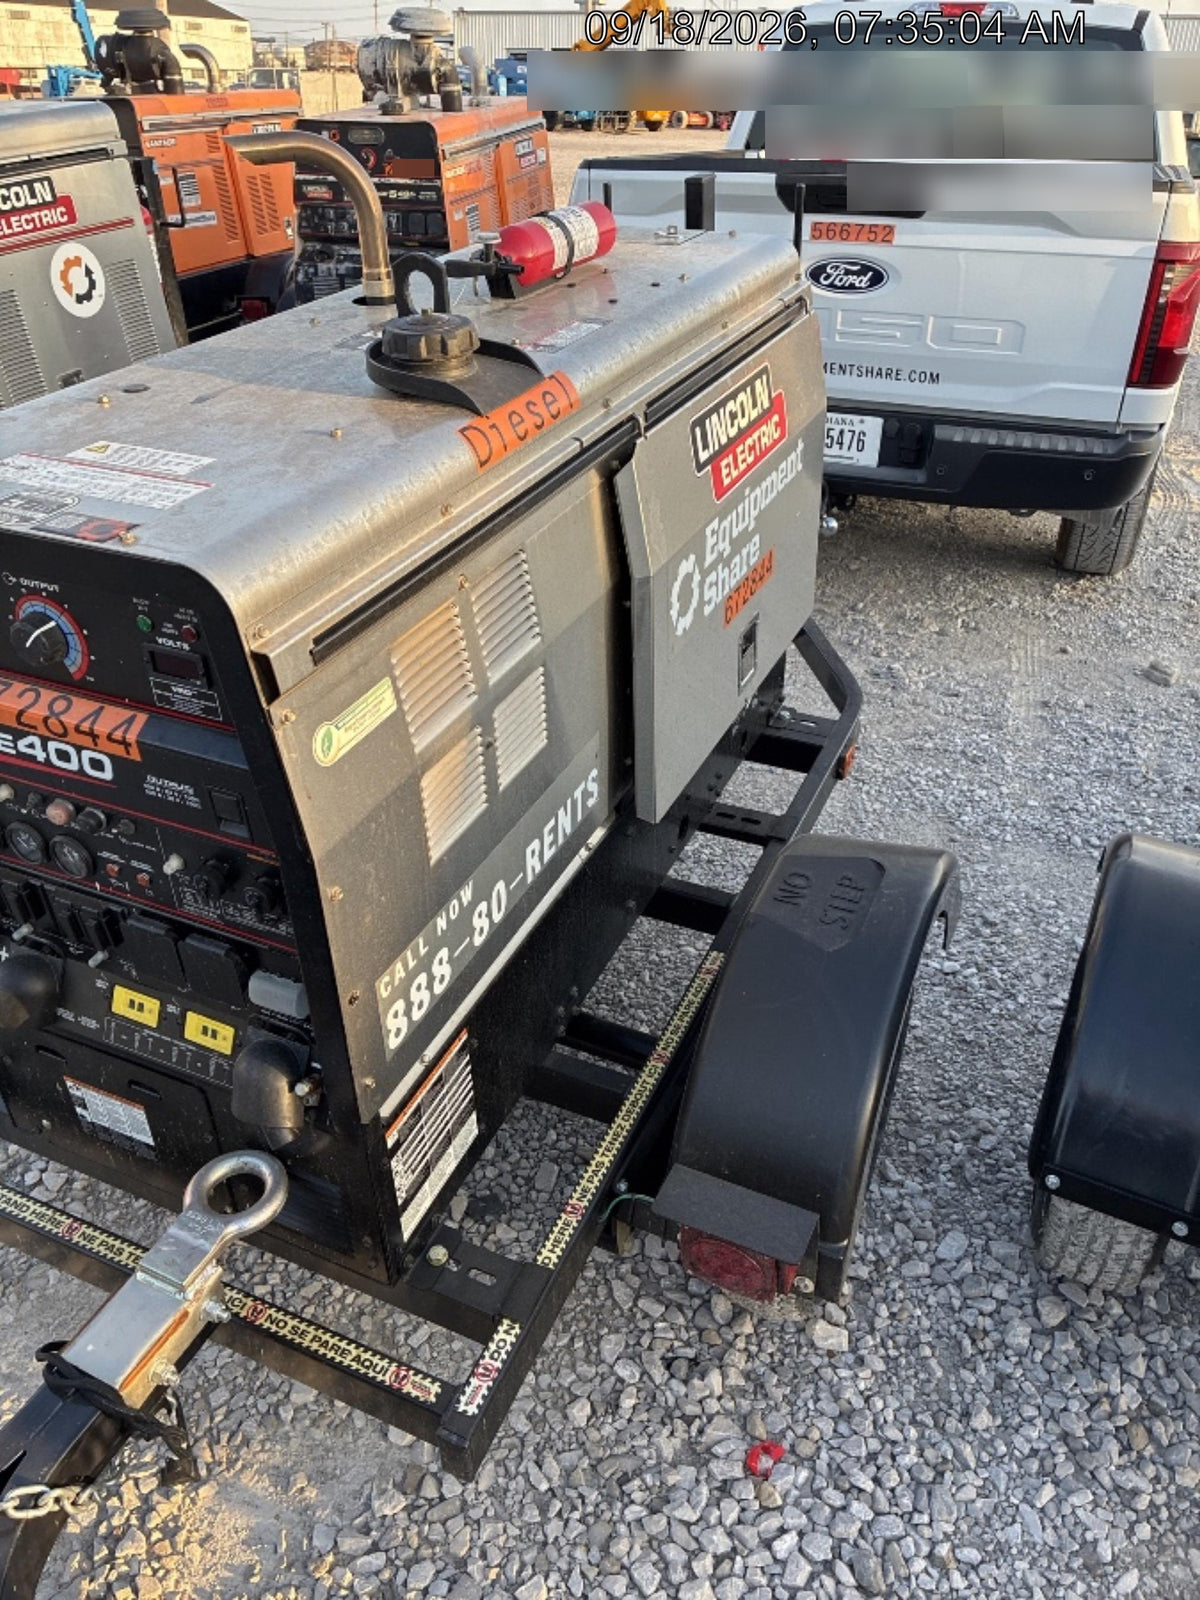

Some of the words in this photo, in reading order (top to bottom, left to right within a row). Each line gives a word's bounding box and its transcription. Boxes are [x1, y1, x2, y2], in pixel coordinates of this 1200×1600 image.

[811, 222, 894, 243] 566752
[819, 262, 875, 289] Ford
[458, 374, 574, 468] Diesel
[694, 374, 771, 464] LINCOLN
[825, 427, 867, 452] 5476
[719, 413, 782, 488] ELECTRIC
[703, 437, 805, 570] Equipment
[704, 533, 761, 617] Share
[386, 768, 600, 1050] 888-80-RENTS
[773, 872, 812, 907] NO
[818, 875, 865, 931] STEP
[379, 938, 429, 998] CALL
[436, 880, 475, 936] NOW
[586, 1159, 606, 1184] PAS
[30, 1209, 64, 1231] HERE
[549, 1217, 573, 1255] HERE
[79, 1231, 99, 1245] NE
[97, 1238, 125, 1260] PAS
[264, 1313, 289, 1331] NO
[288, 1324, 311, 1342] SE
[310, 1334, 353, 1361] PARE
